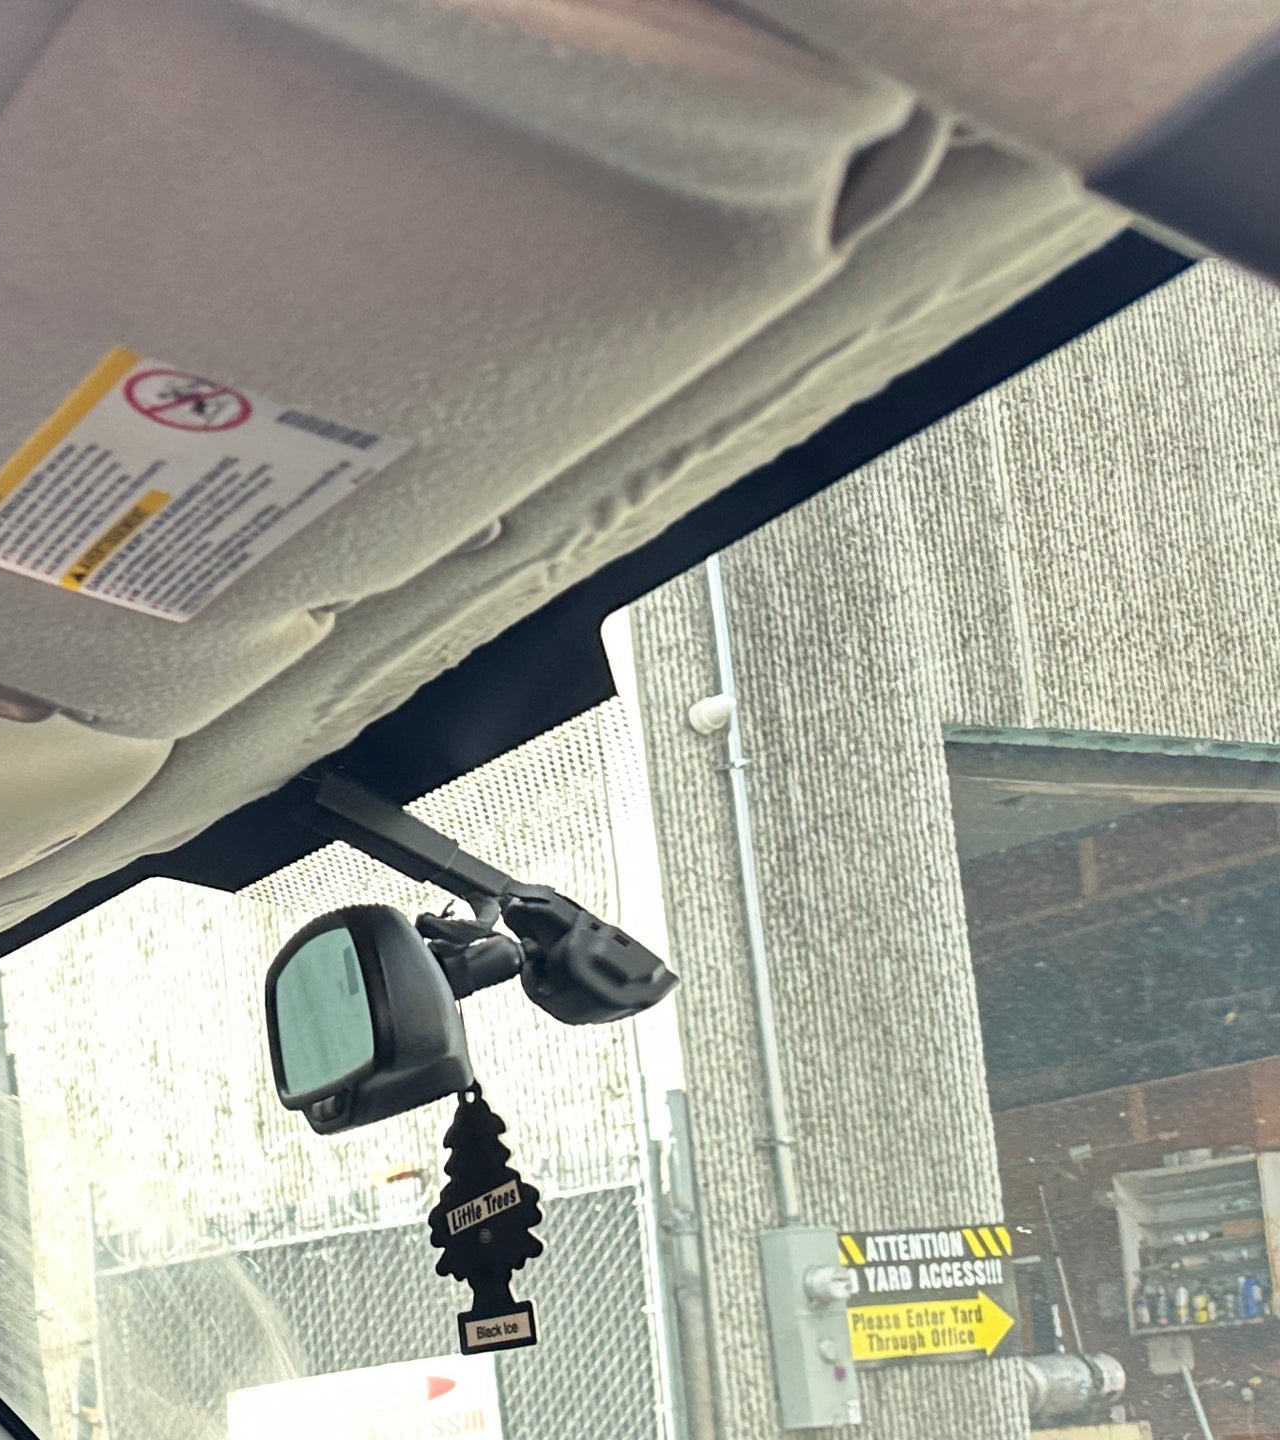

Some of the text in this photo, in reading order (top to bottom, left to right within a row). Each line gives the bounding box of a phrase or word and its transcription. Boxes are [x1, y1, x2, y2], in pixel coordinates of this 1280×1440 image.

[451, 1189, 516, 1232] Little Trees
[866, 1231, 964, 1262] ATTENTION
[864, 1265, 913, 1293] YARD
[919, 1259, 1003, 1290] ACCESS!!!
[476, 1321, 519, 1340] Black Ice
[852, 1304, 983, 1332] Please Enter Yard
[866, 1328, 976, 1355] Through Office
